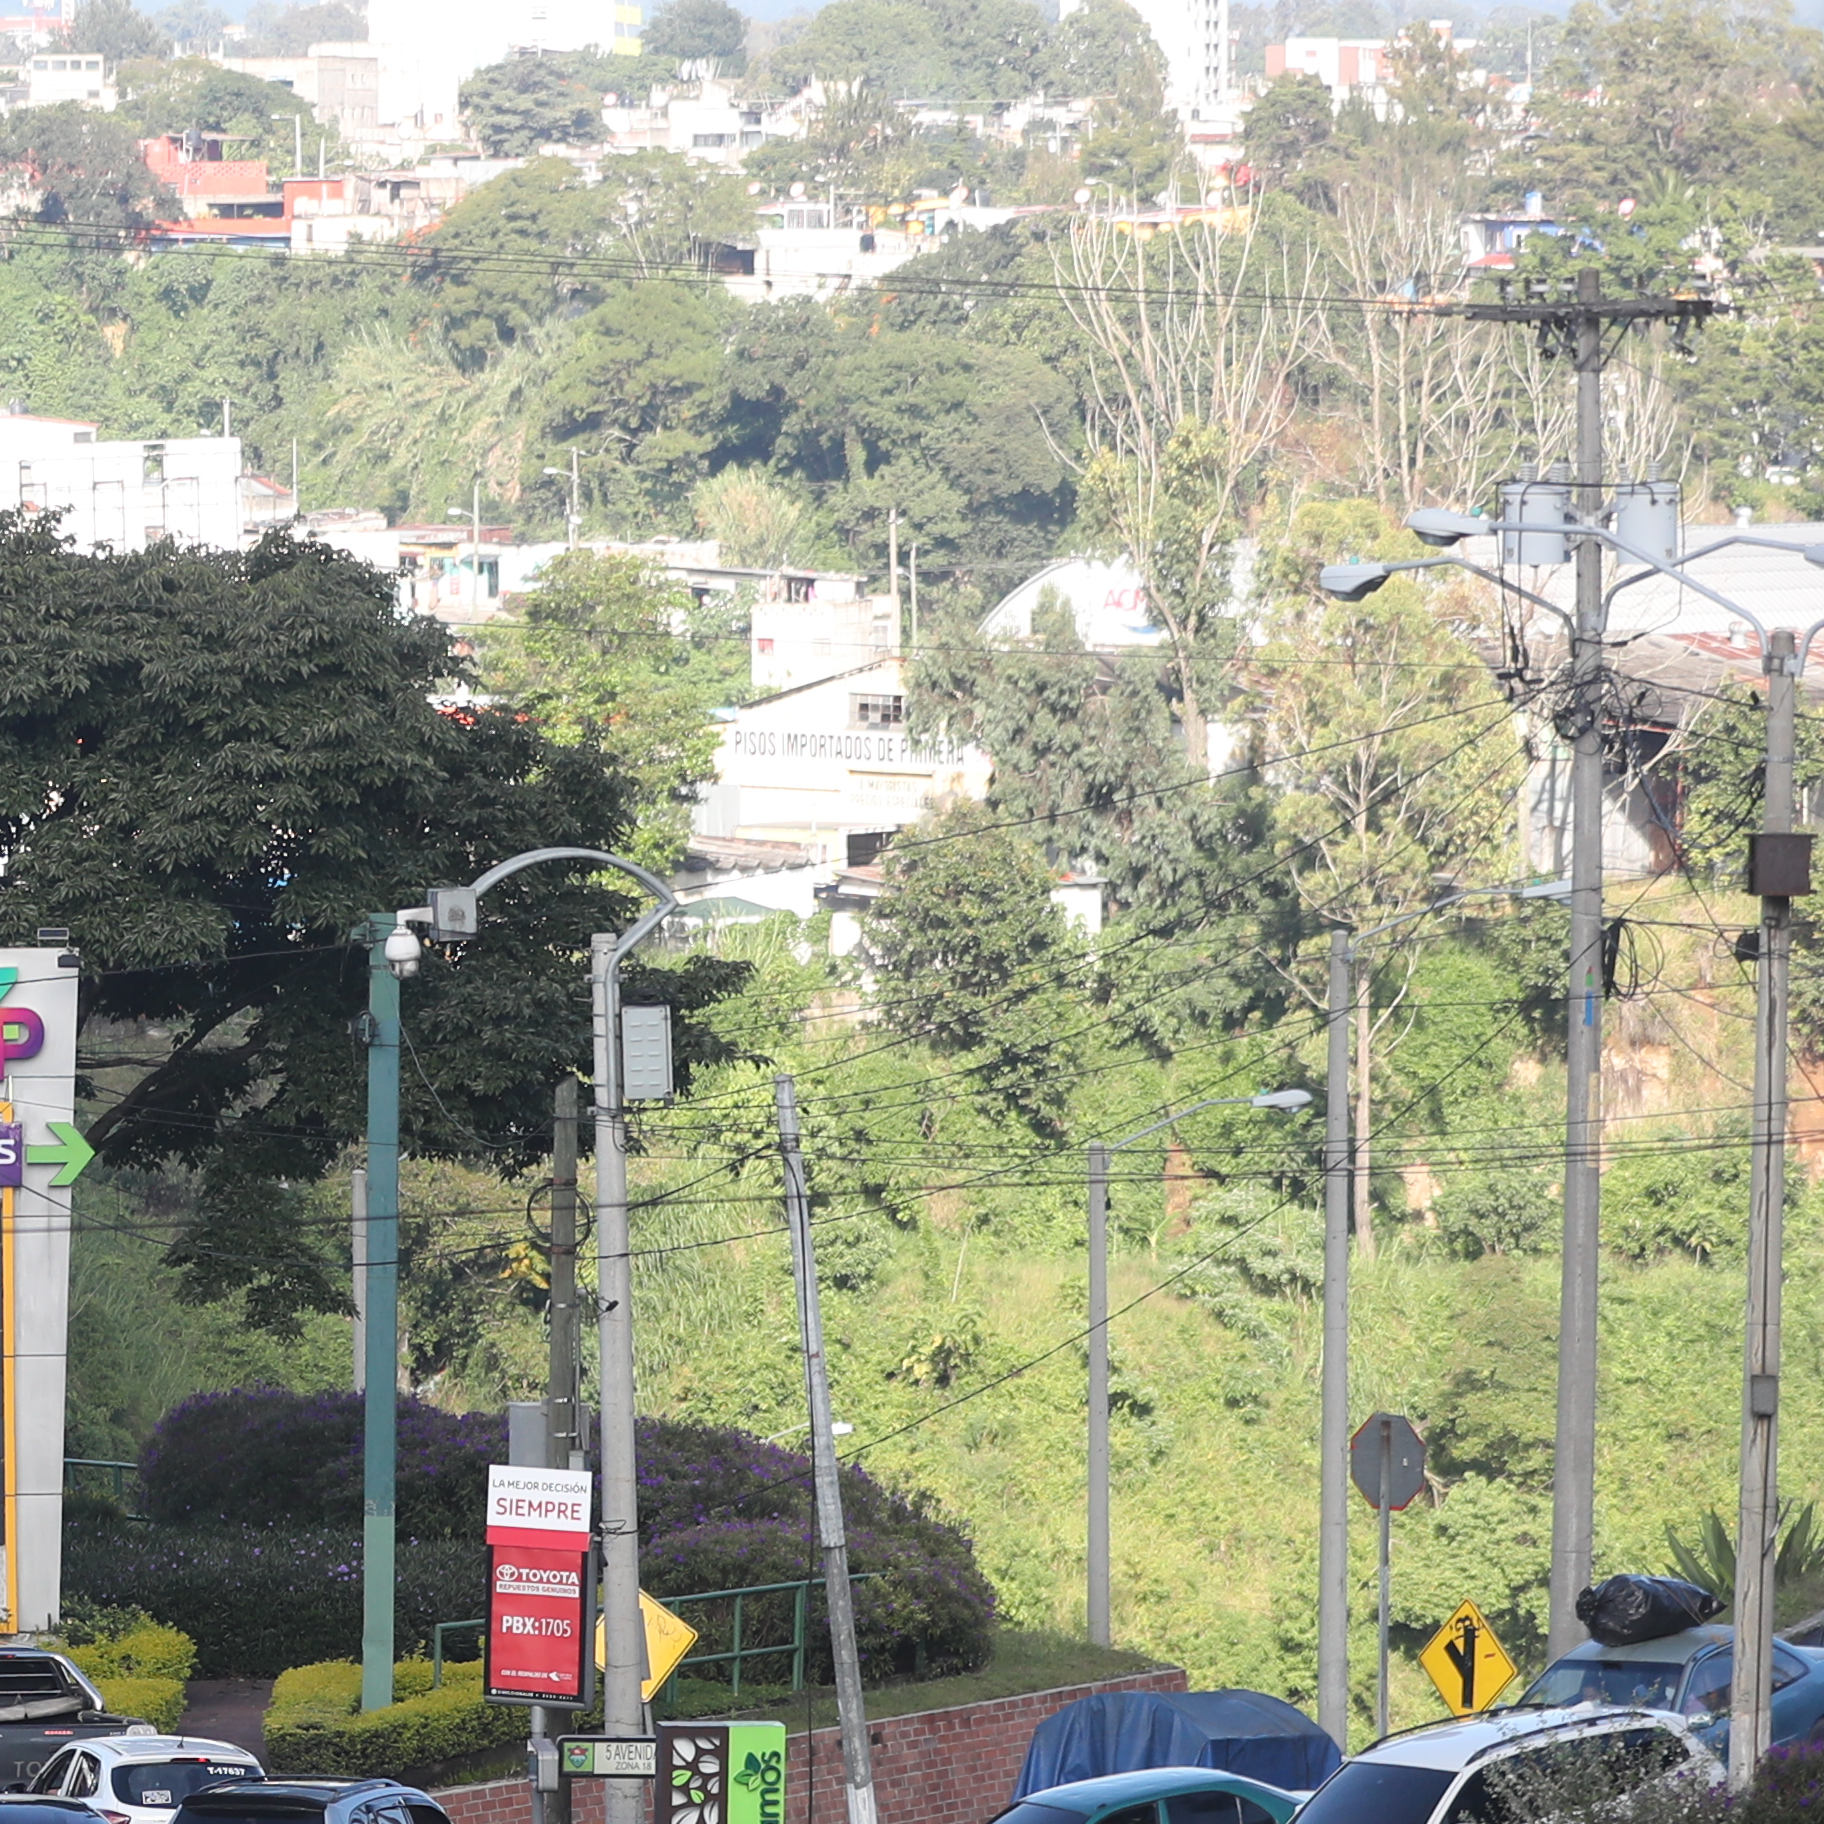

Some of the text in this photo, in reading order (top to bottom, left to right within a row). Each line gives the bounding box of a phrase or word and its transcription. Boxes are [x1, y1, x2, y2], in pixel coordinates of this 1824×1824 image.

[735, 729, 777, 757] PISOS
[781, 732, 873, 761] IMPORTADOS
[878, 737, 895, 763] DE
[492, 1478, 588, 1494] LA MEJOR DECISIÓN
[495, 1498, 582, 1521] SIEMPRE
[519, 1568, 580, 1585] TOYOTA
[498, 1583, 540, 1593] REPUESTOS
[605, 1745, 612, 1760] 5
[615, 1760, 652, 1771] ZONA 18
